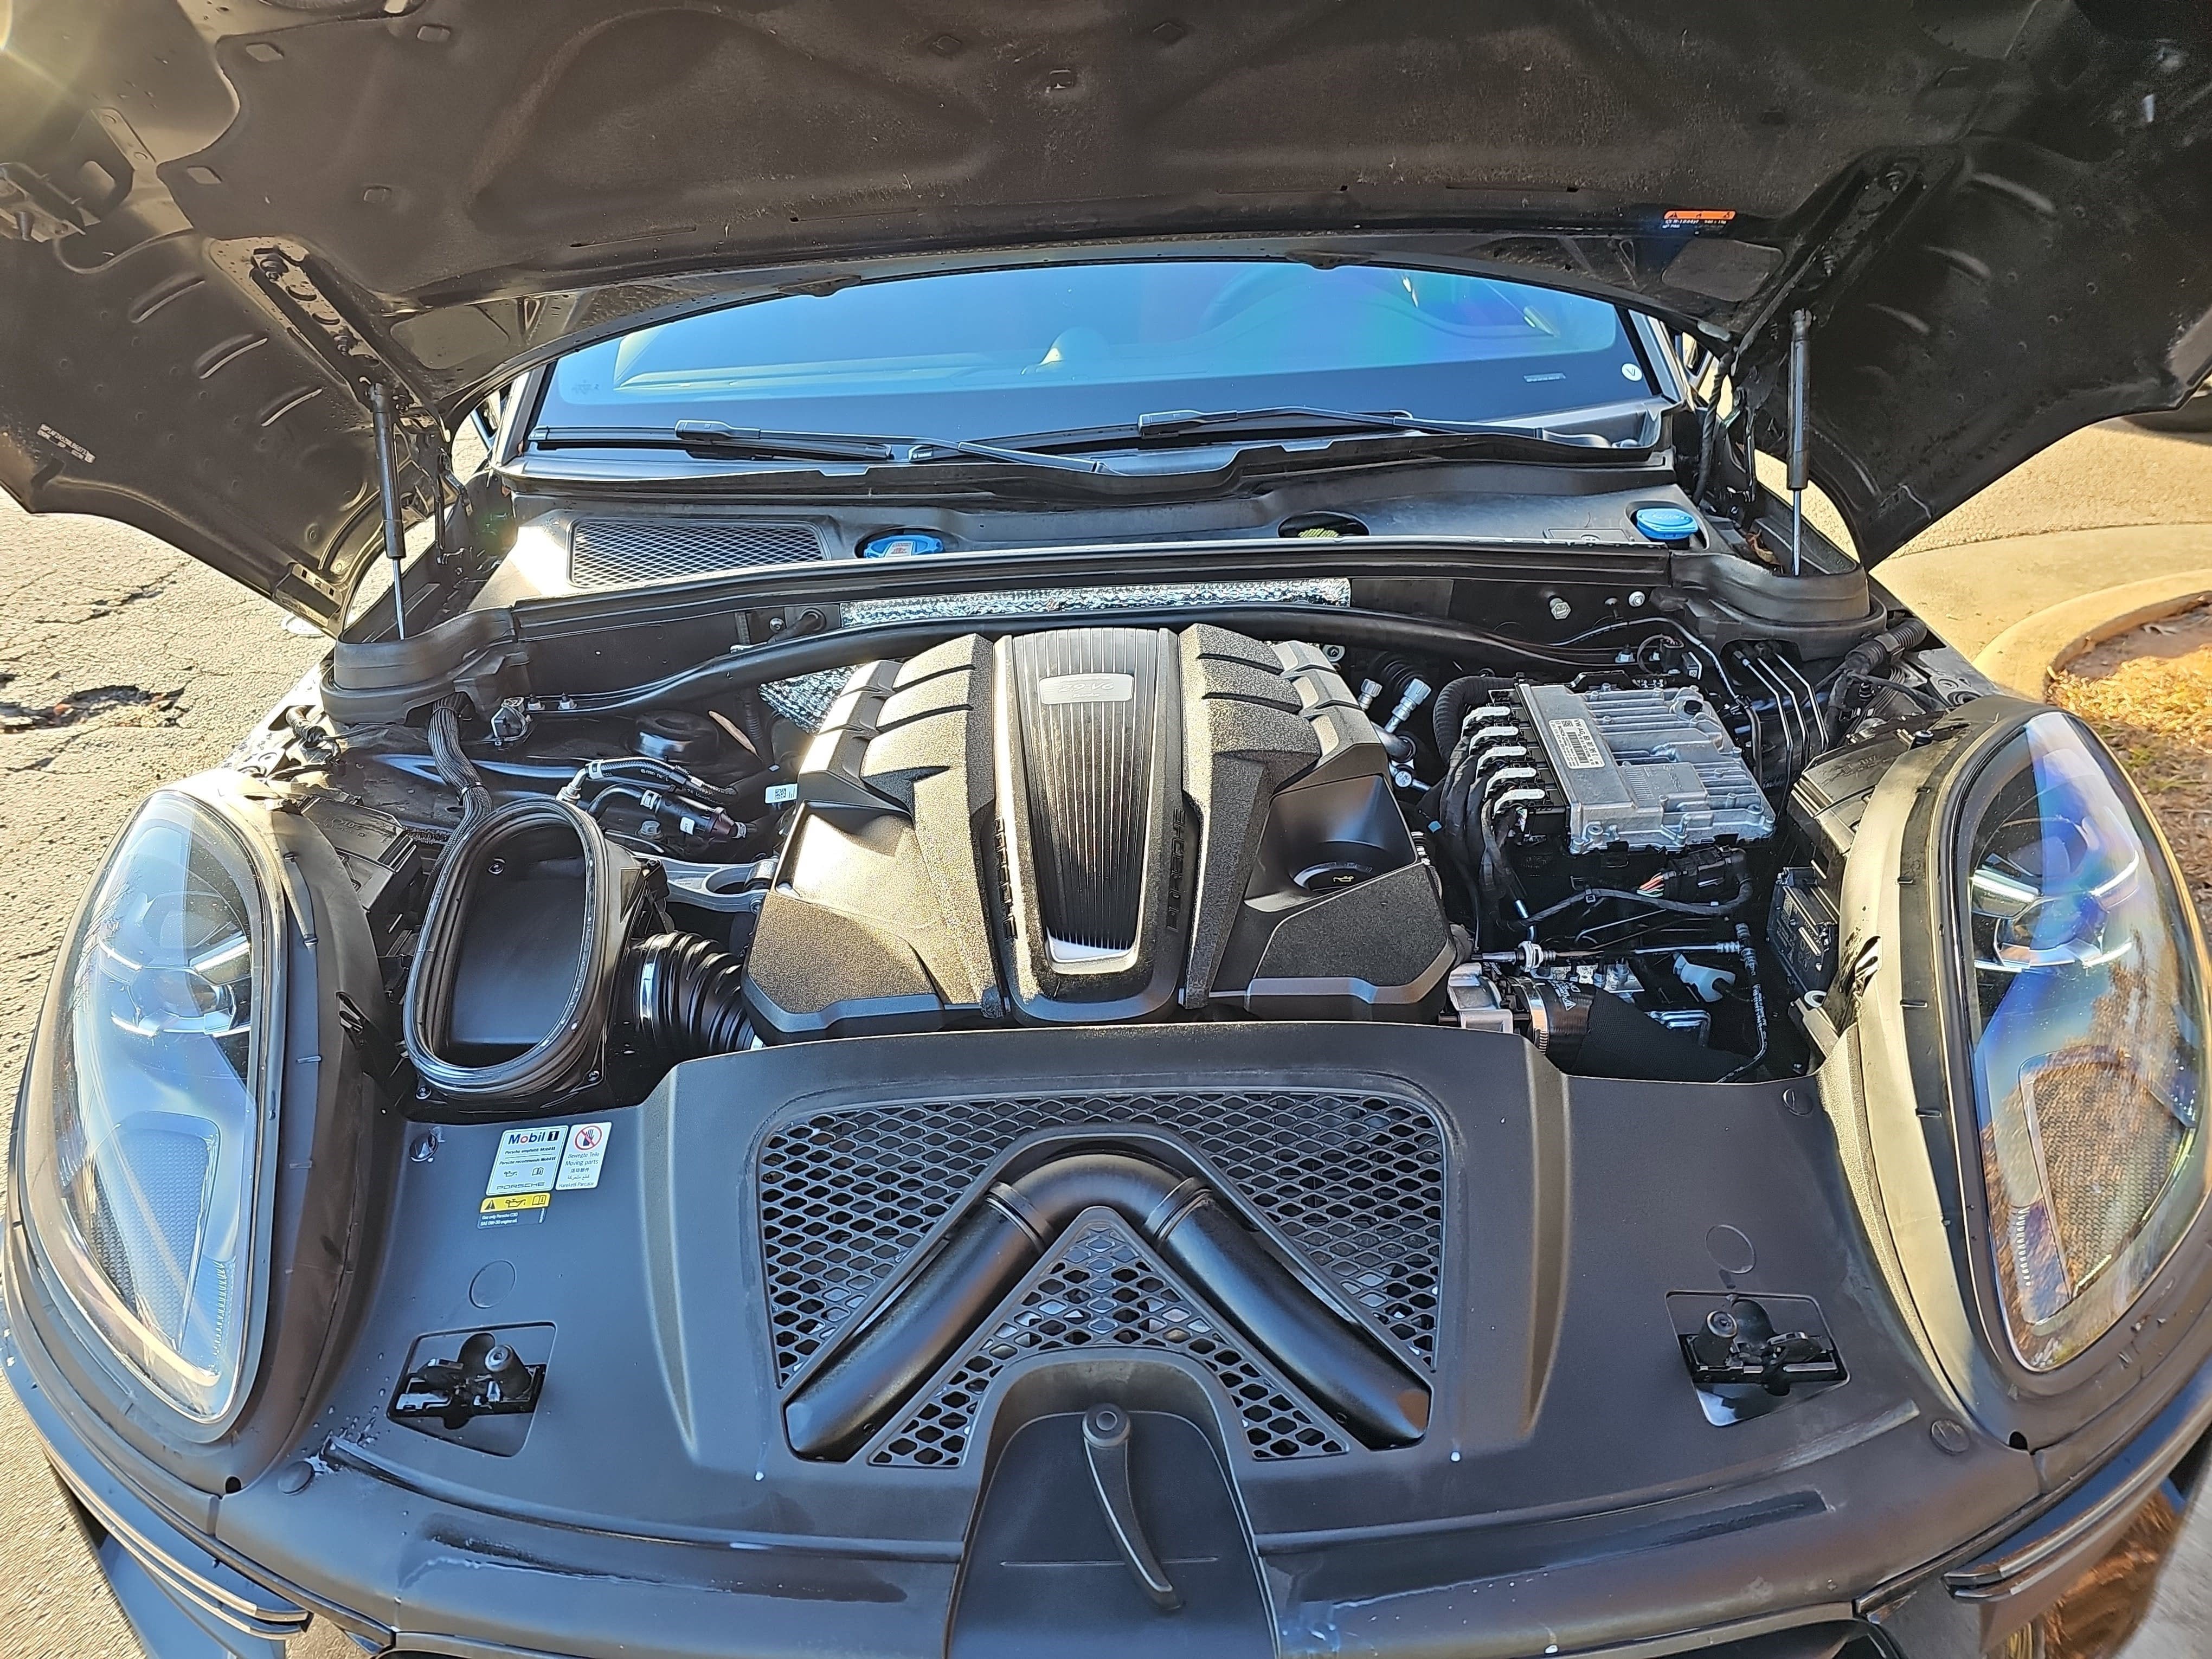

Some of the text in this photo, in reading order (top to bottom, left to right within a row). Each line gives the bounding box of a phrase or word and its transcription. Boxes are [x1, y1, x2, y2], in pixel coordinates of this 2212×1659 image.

[508, 1131, 558, 1144] Mobil 1
[497, 1182, 545, 1190] PORSCHE
